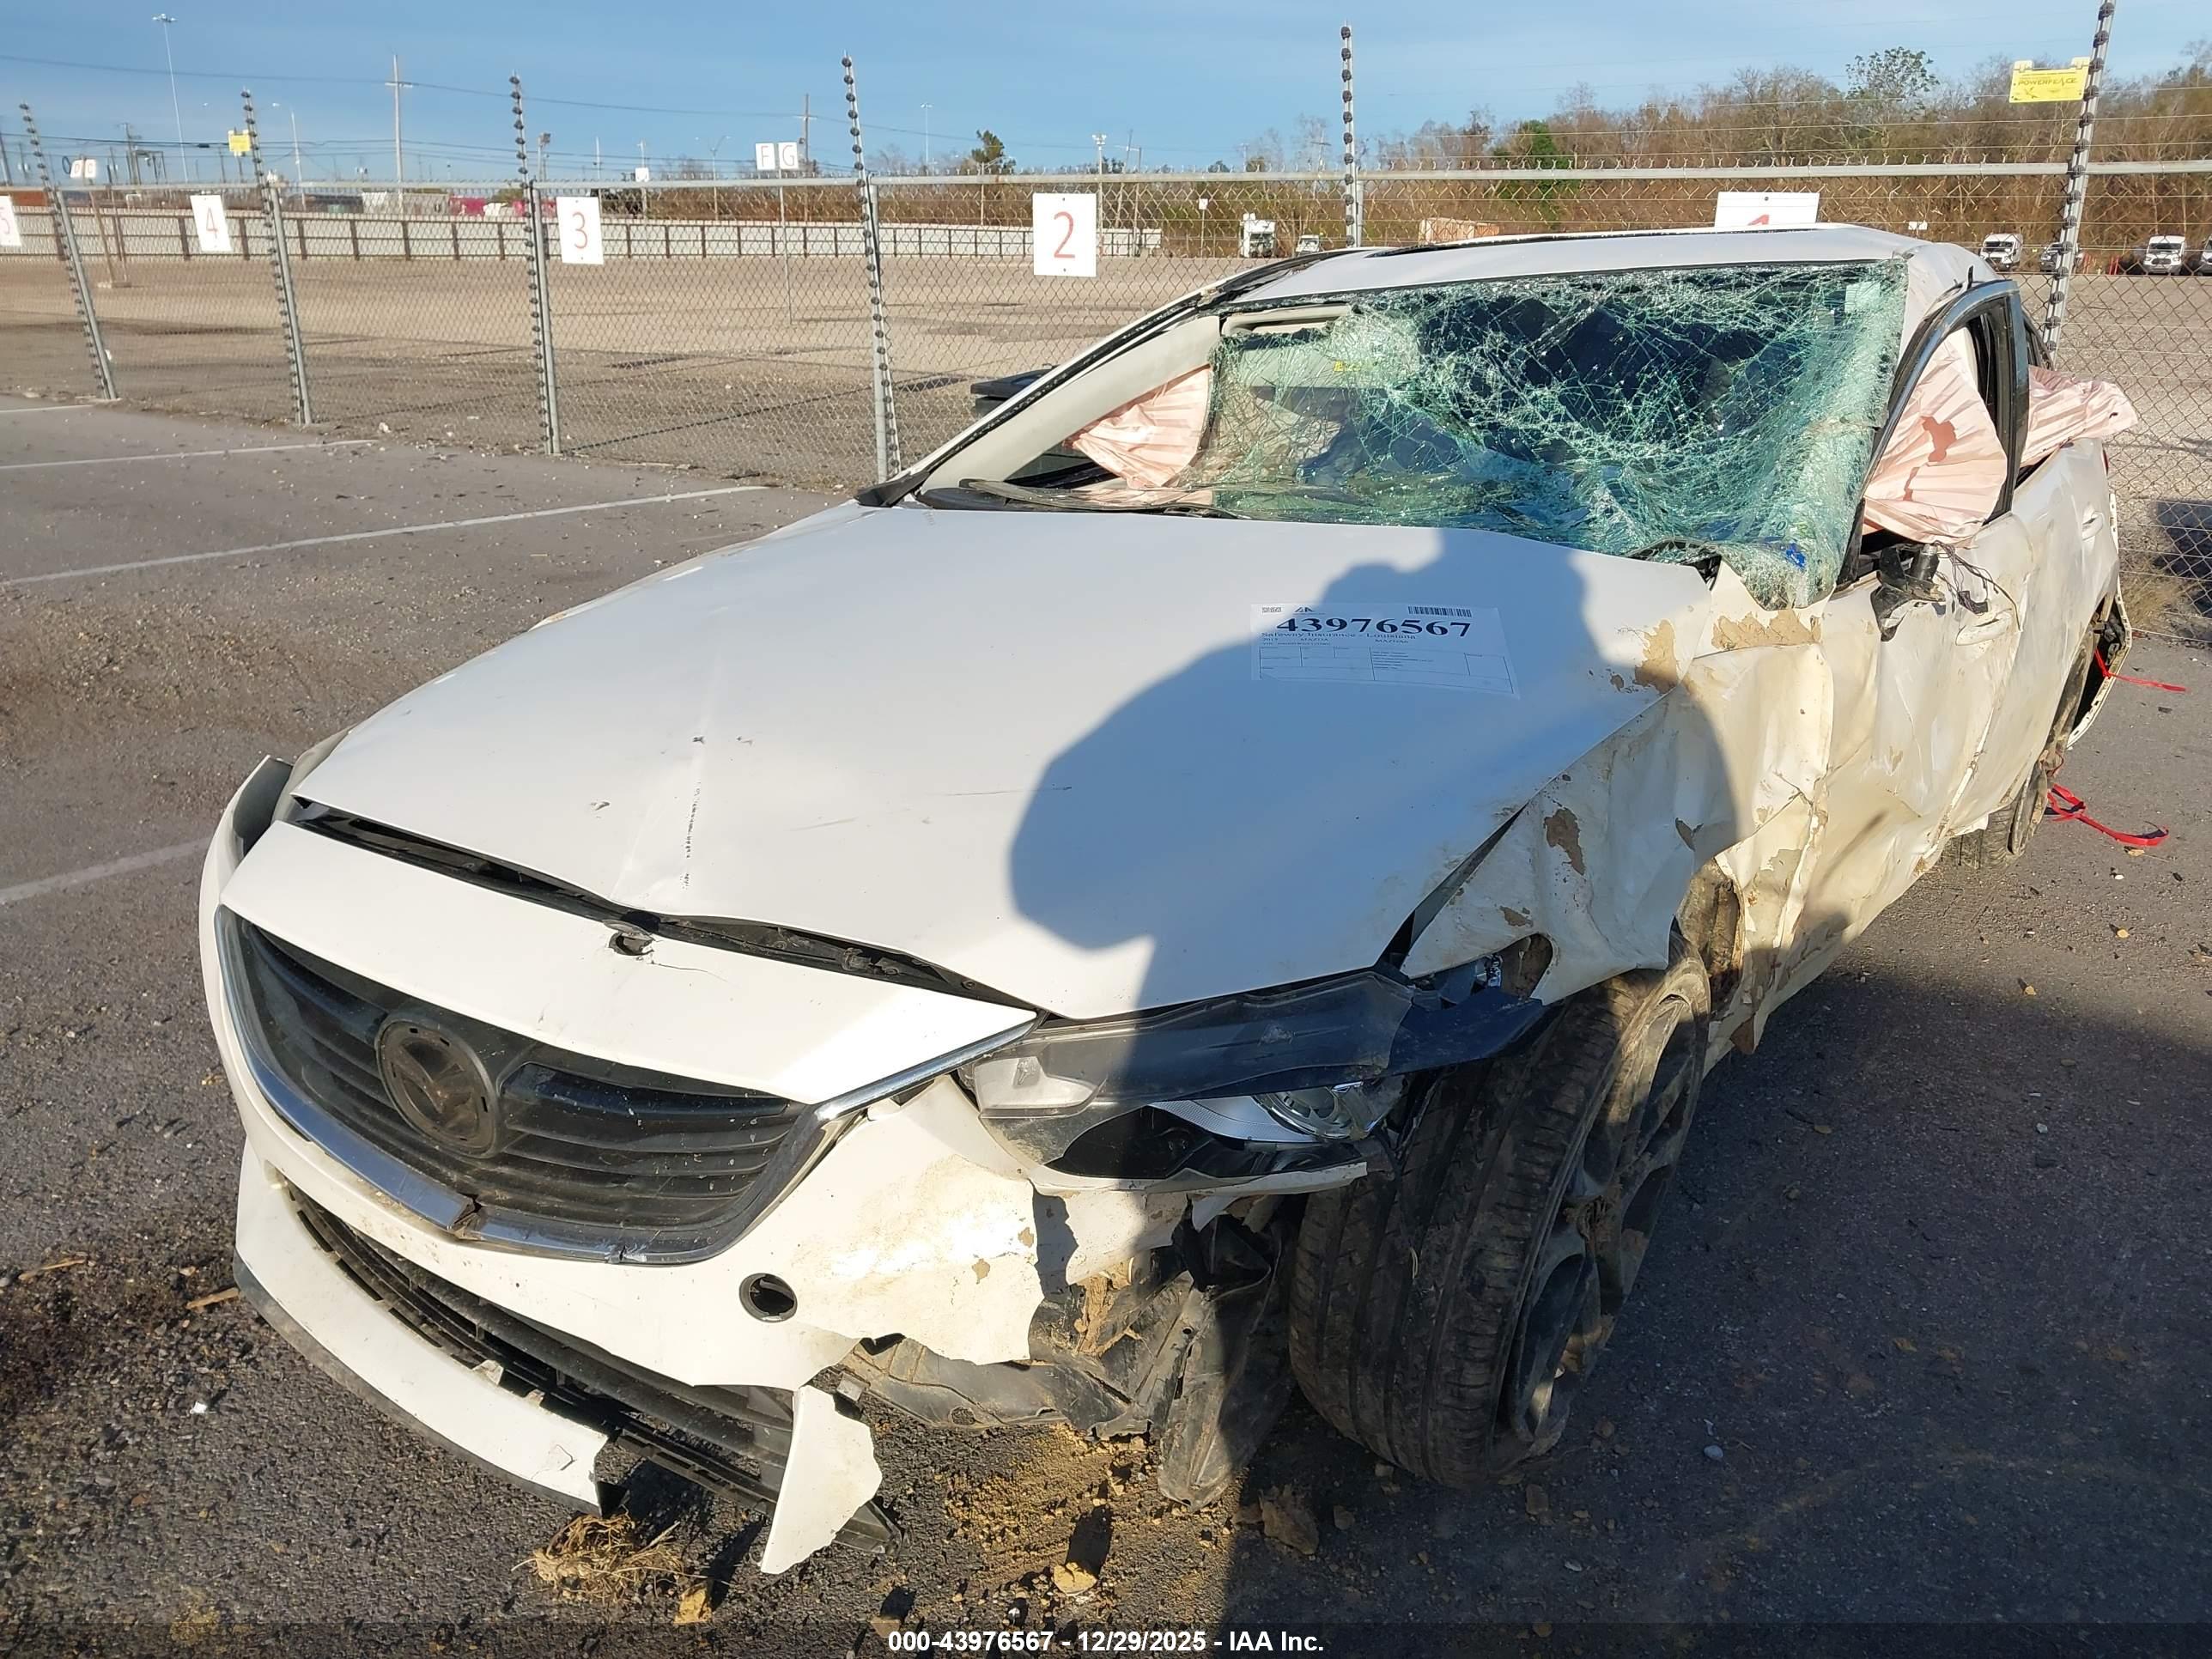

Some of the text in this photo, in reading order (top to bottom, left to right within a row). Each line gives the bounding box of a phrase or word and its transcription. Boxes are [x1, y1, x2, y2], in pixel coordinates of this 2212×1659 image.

[761, 145, 770, 167] F
[782, 144, 795, 167] G
[206, 207, 218, 240] 4
[572, 210, 588, 249] 3
[1054, 211, 1076, 258] 2
[1276, 617, 1471, 637] 43976567
